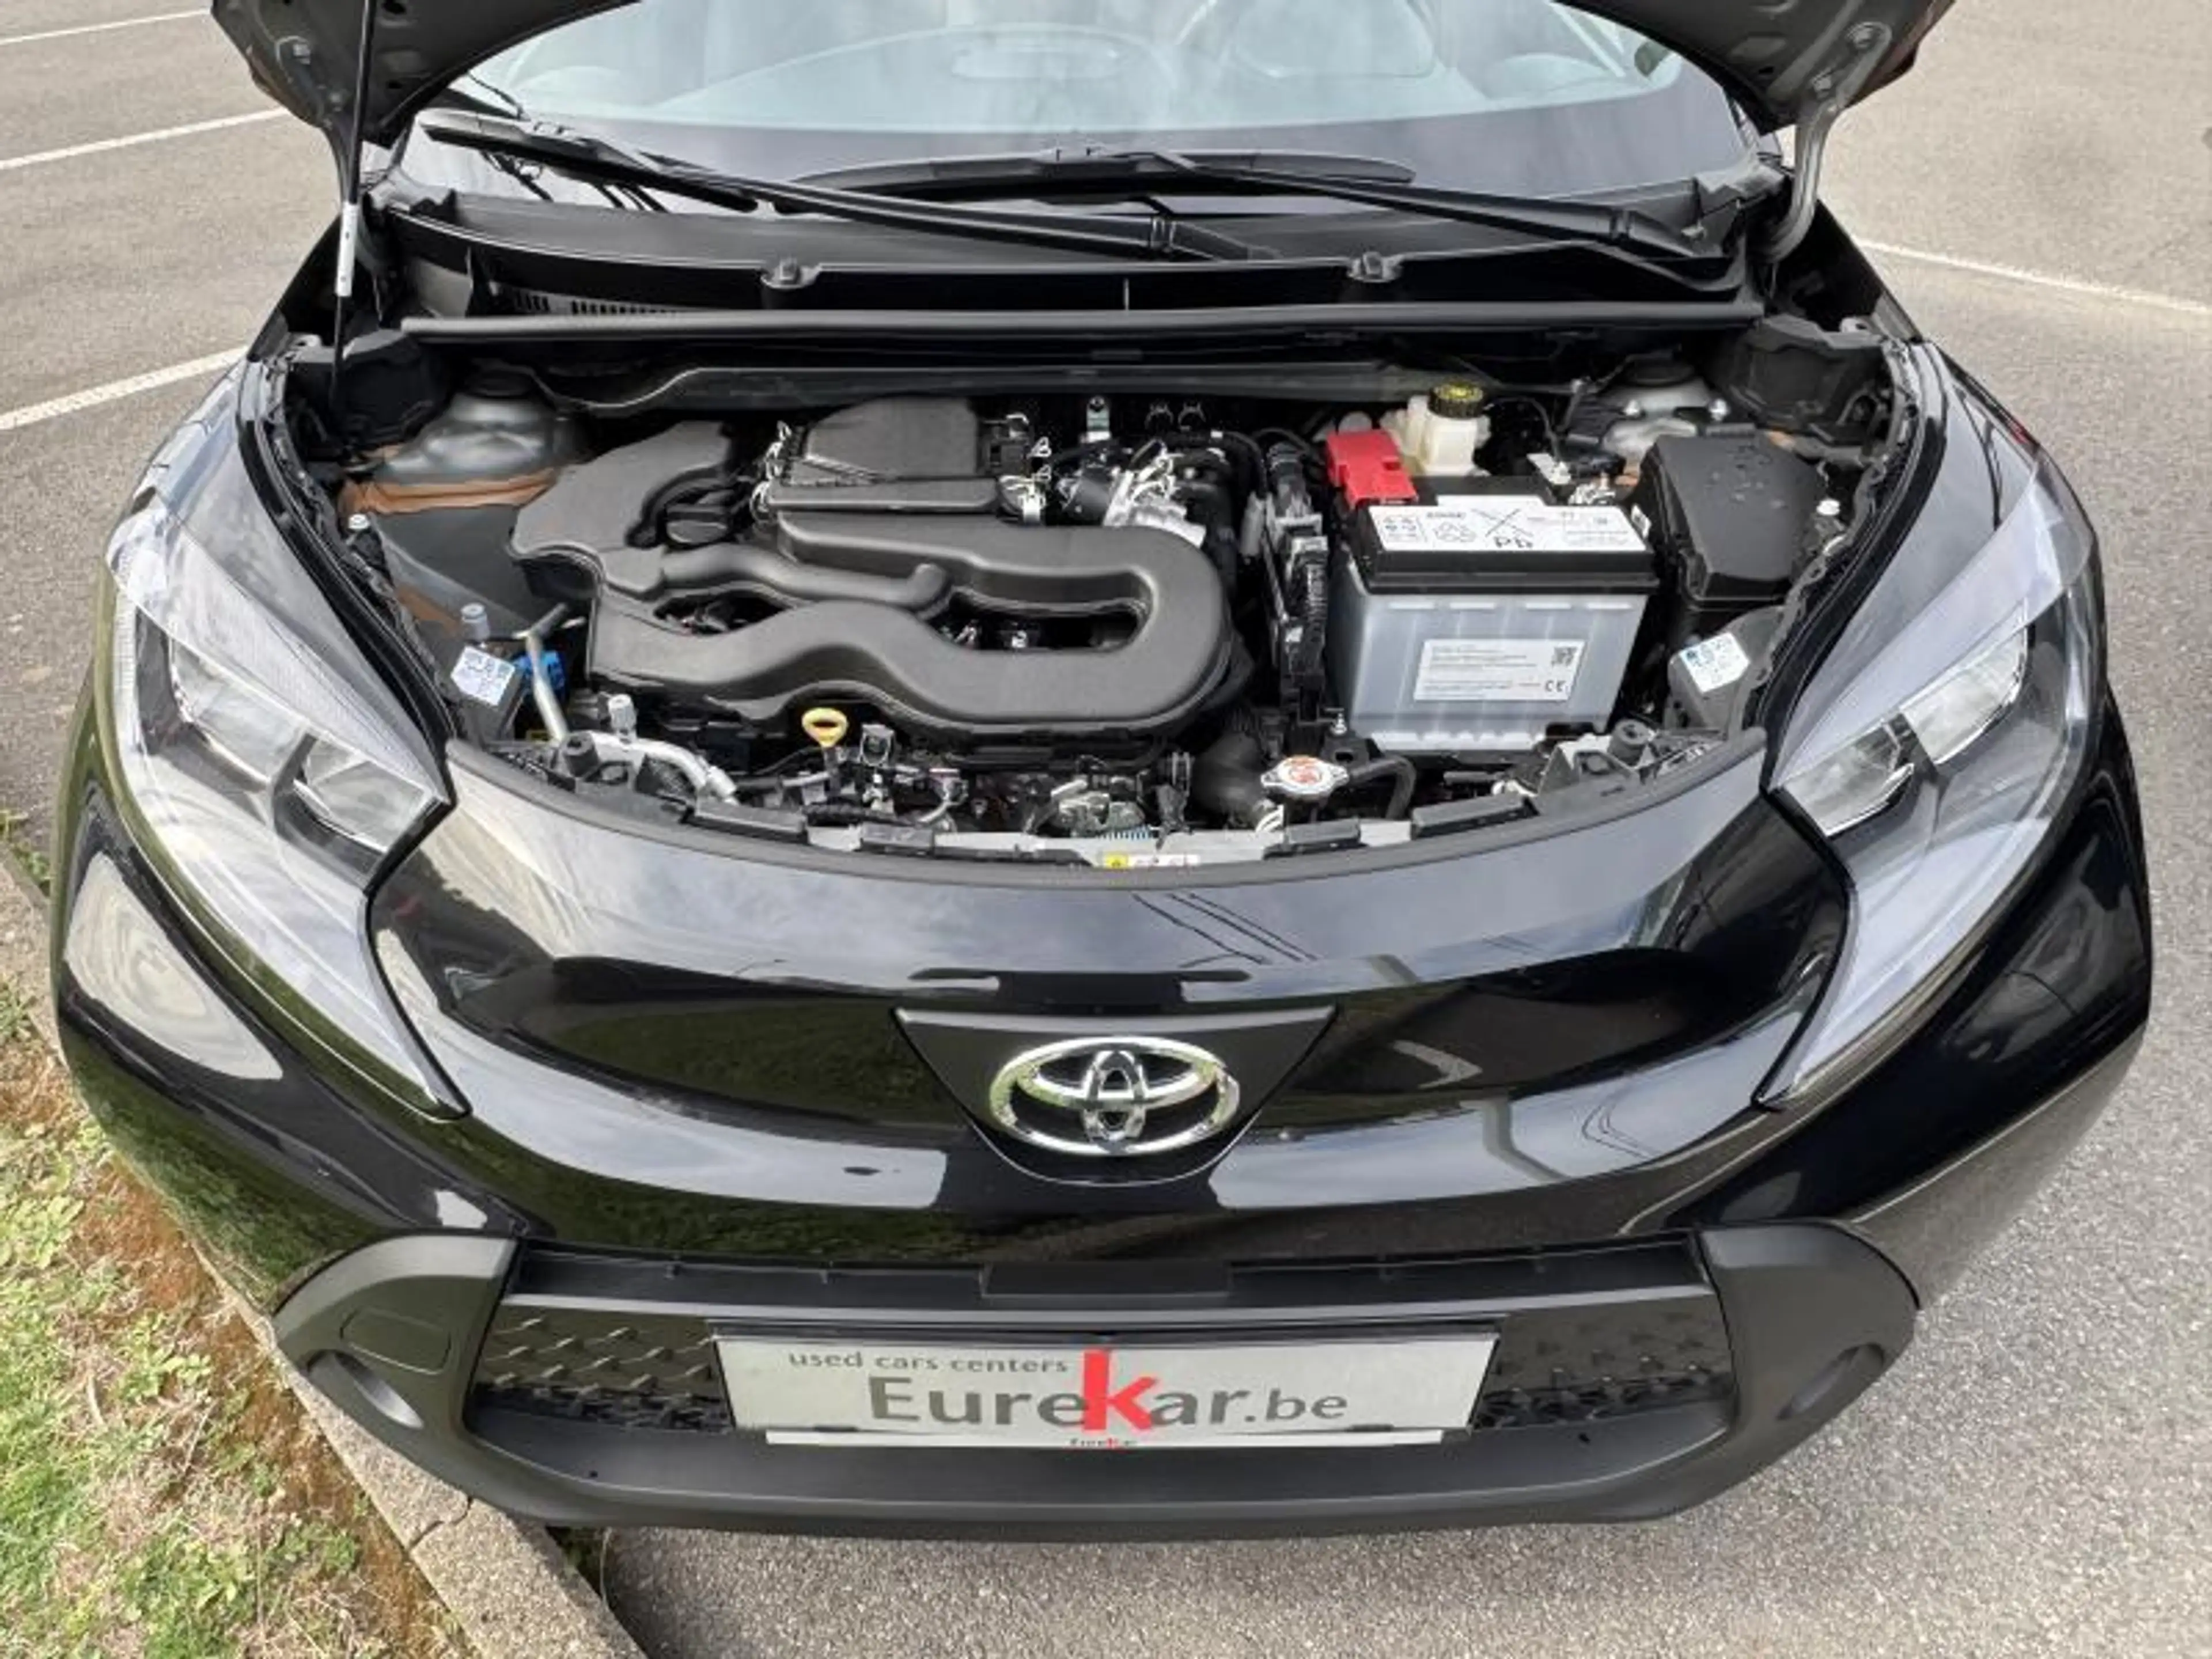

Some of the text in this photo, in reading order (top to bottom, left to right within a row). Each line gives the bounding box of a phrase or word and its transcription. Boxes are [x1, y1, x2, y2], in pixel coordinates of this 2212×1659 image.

[789, 1351, 1069, 1373] used cars centers
